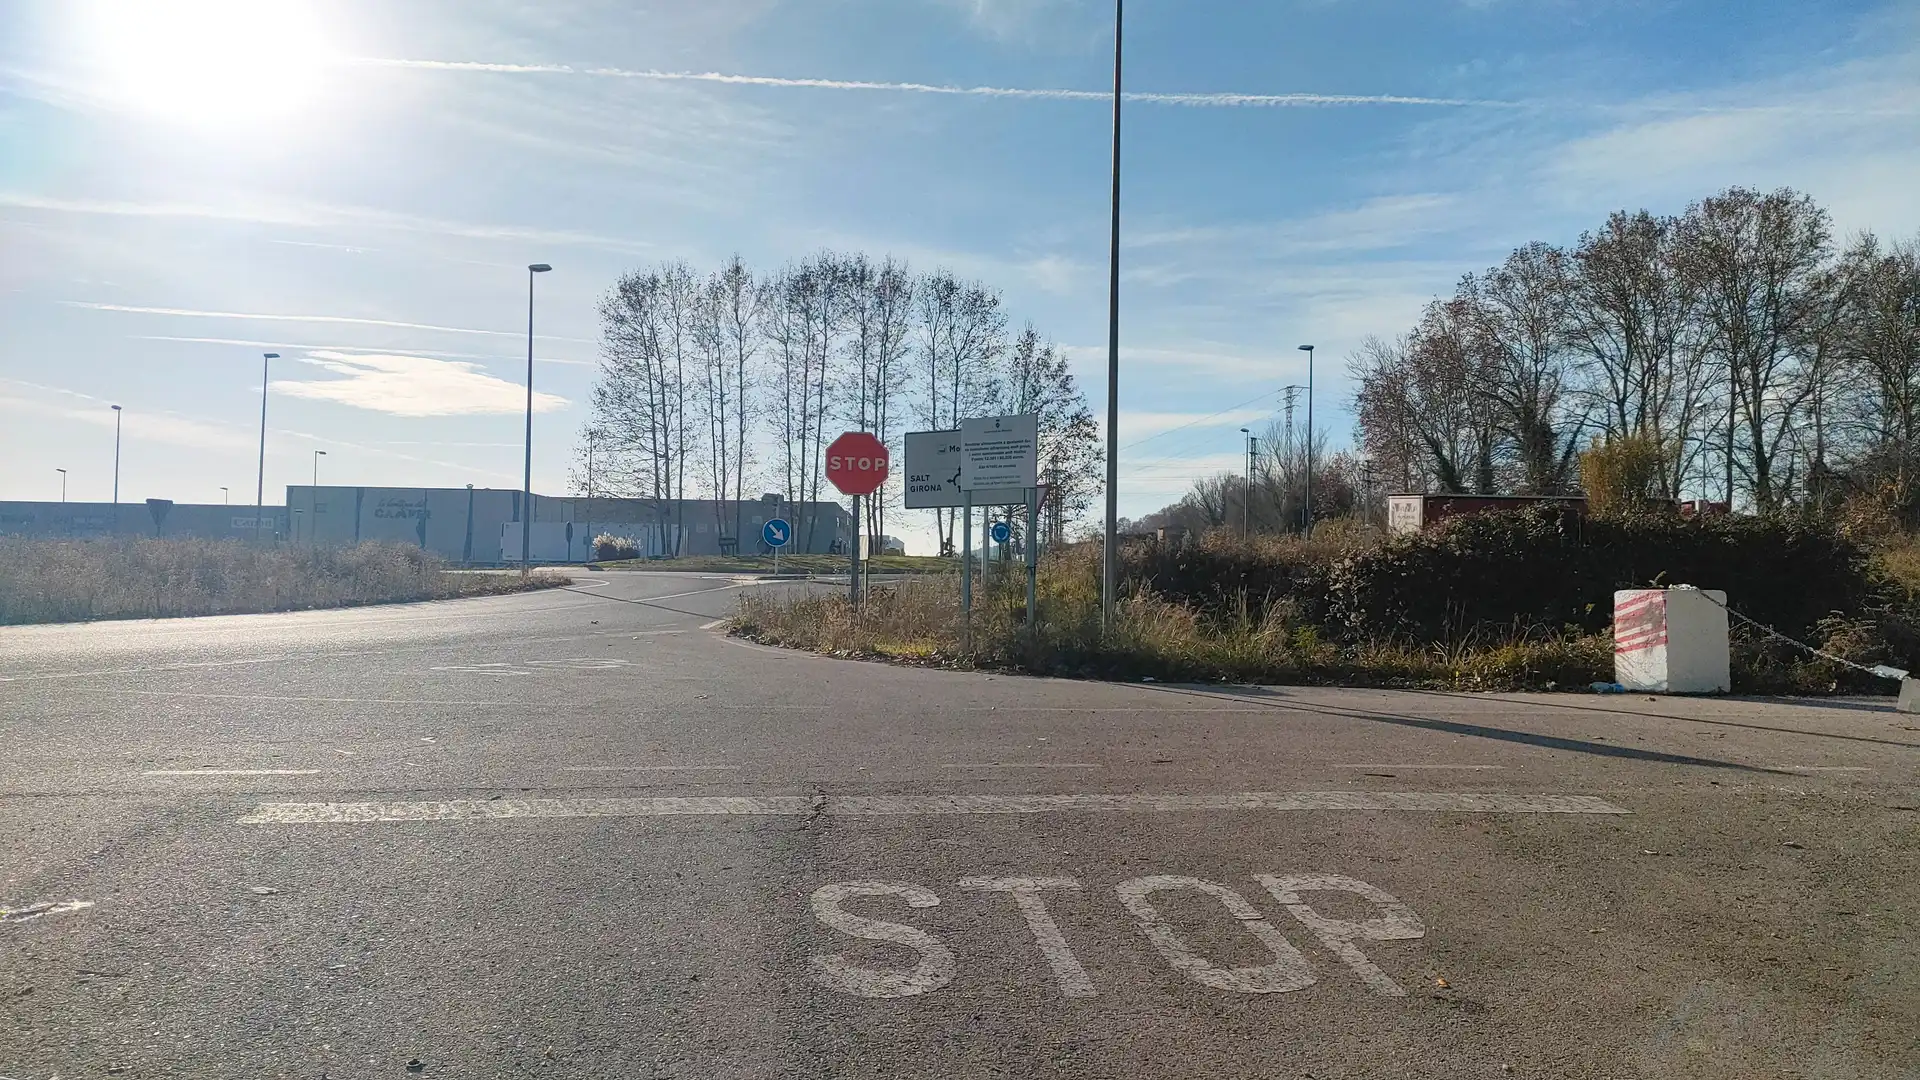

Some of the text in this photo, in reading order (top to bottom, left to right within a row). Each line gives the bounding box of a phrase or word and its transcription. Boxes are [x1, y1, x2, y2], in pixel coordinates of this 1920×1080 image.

[830, 455, 886, 472] STOP
[910, 474, 931, 482] SALT
[910, 484, 942, 493] GIRONA
[810, 873, 1426, 1000] STOP
